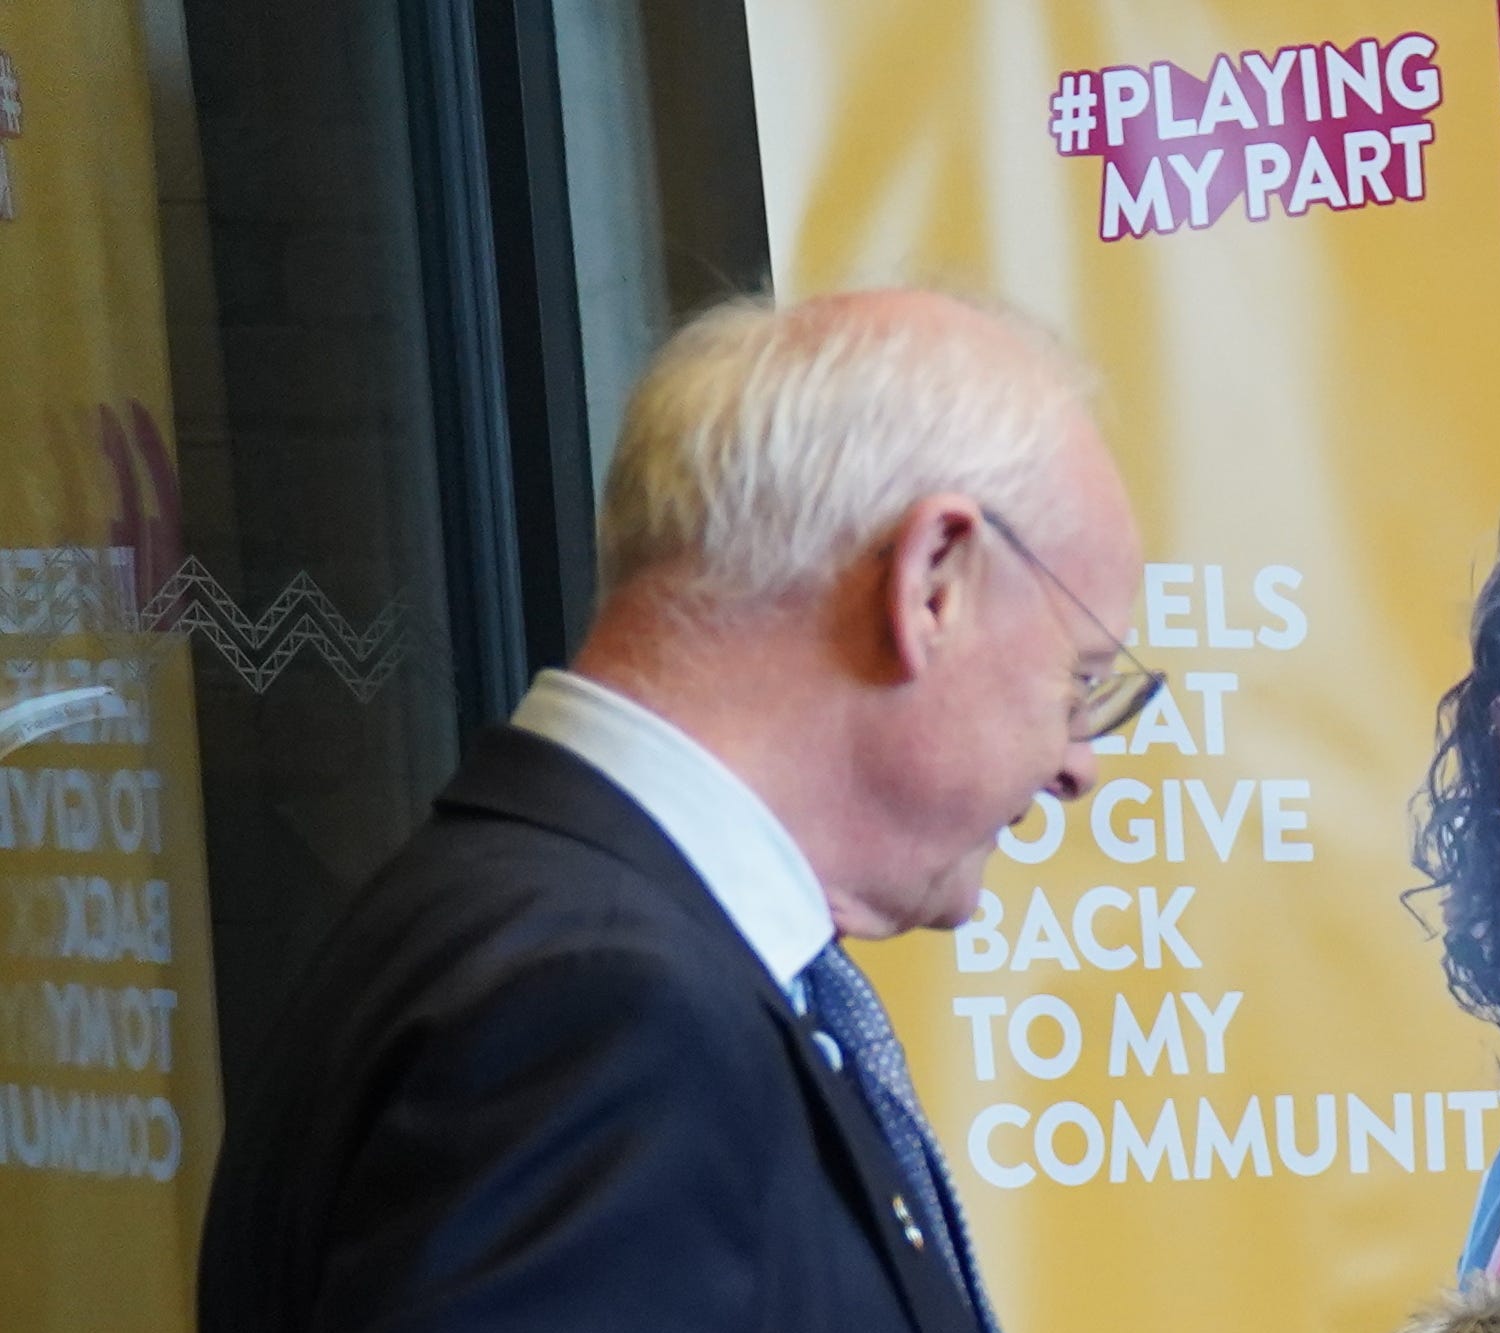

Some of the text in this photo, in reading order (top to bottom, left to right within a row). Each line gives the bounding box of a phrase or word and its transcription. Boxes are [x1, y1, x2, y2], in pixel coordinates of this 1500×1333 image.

[1052, 36, 1440, 152] #PLAYING
[1100, 124, 1432, 240] MY PART
[1124, 562, 1308, 652] ELS
[1089, 777, 1315, 865] GIVE
[952, 885, 1202, 974] BACK
[952, 990, 1244, 1082] TO MY
